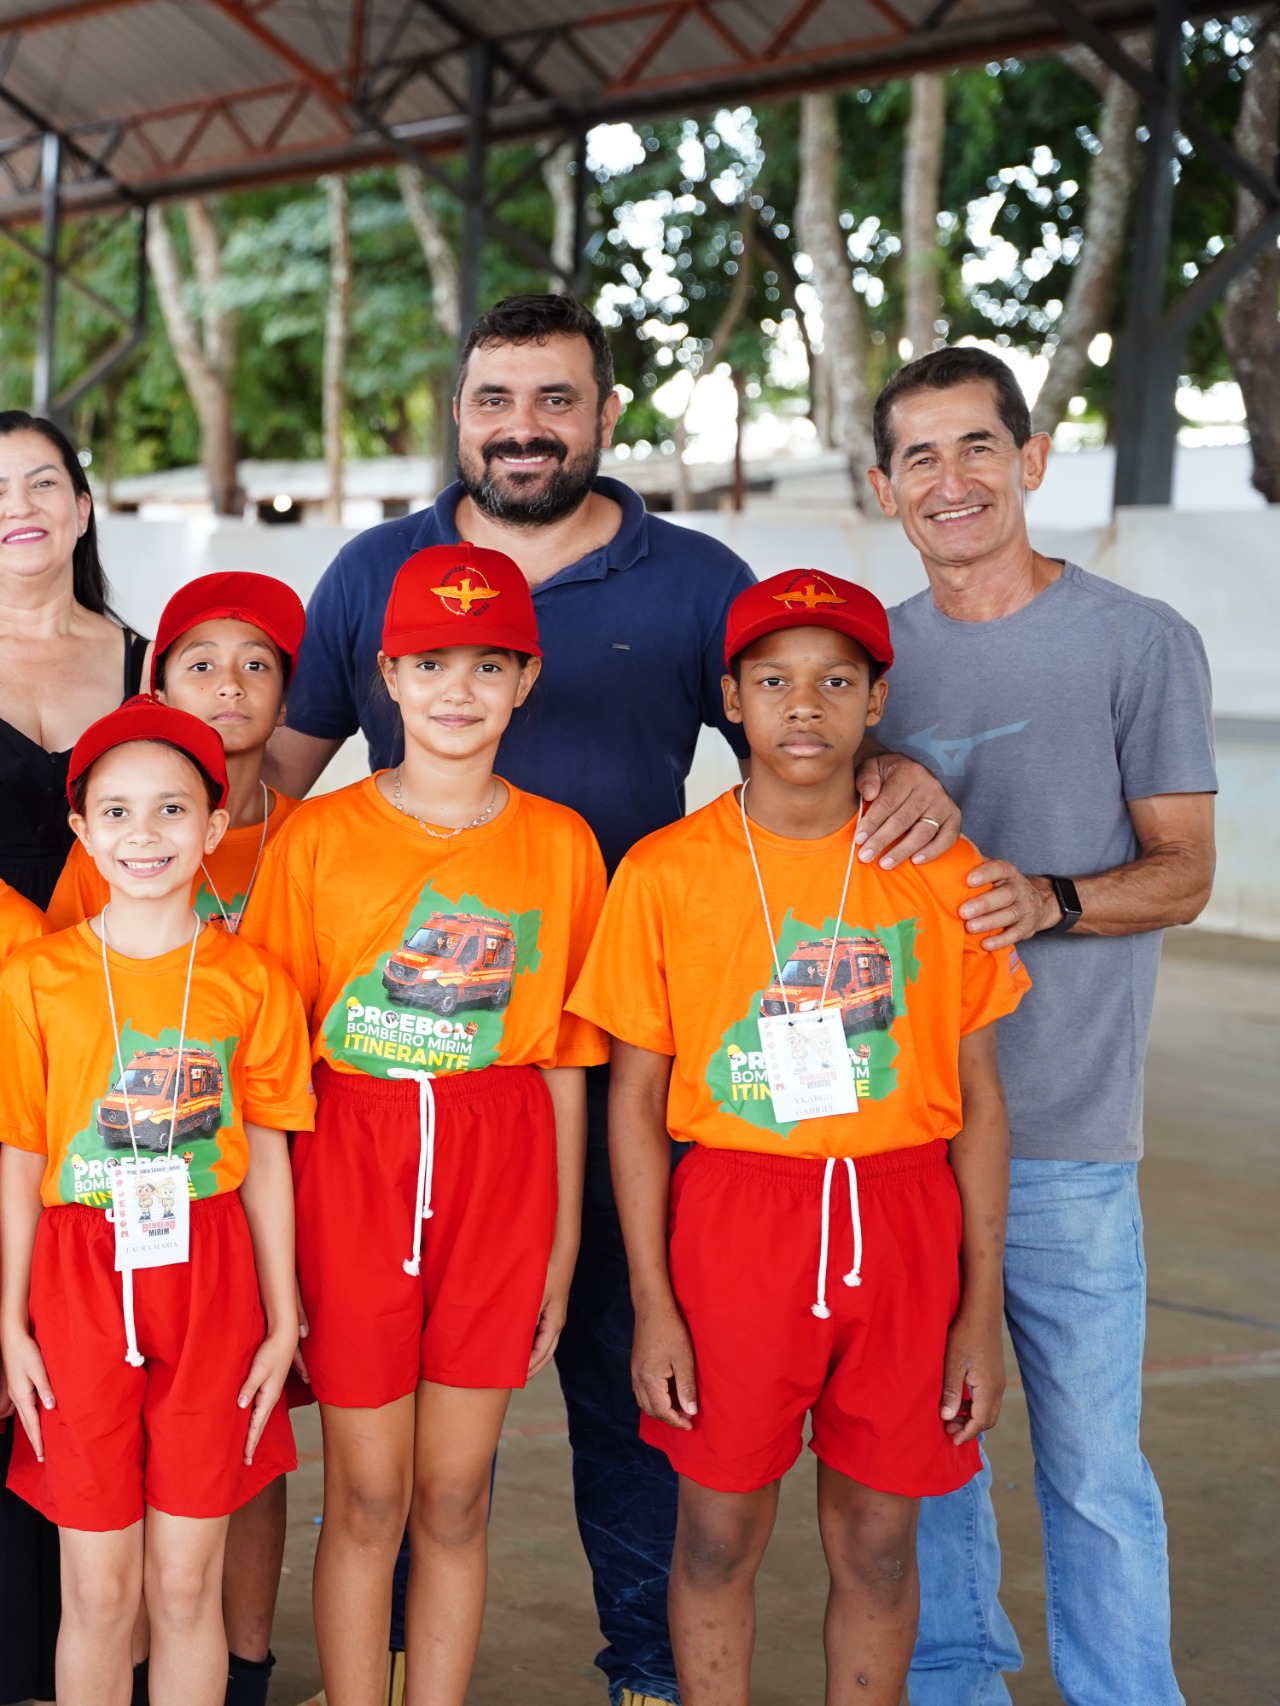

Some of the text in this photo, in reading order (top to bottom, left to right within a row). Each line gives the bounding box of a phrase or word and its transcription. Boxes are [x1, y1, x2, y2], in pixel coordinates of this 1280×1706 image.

[347, 1022, 472, 1054] BOMBEIRO MIRIM
[344, 1034, 469, 1070] ITINERANTE
[142, 1219, 176, 1233] BOMBEIRO
[148, 1227, 170, 1237] MIRIM
[126, 1241, 179, 1254] LAURA MARIA
